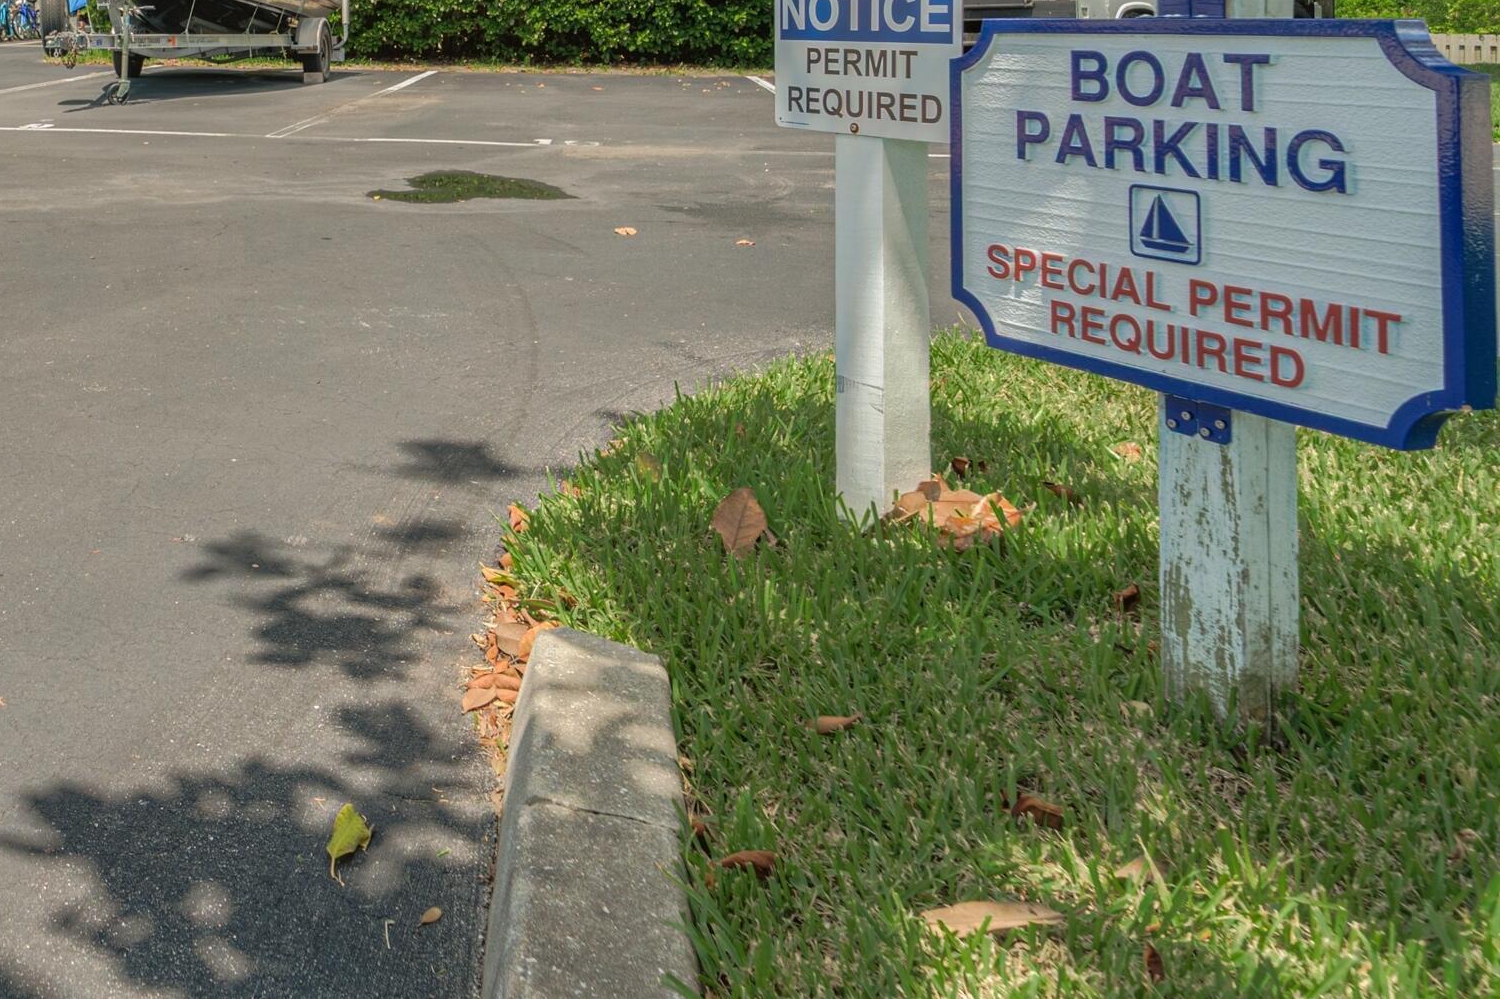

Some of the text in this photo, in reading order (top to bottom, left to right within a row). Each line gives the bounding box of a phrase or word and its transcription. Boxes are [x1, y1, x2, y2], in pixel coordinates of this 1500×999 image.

[806, 47, 918, 79] PERMIT
[1070, 49, 1271, 112] BOAT
[788, 86, 942, 123] REQUIRED
[1016, 110, 1349, 195] PARKING
[986, 244, 1402, 354] SPECIAL PERMIT
[1050, 300, 1305, 388] REQUIRED
